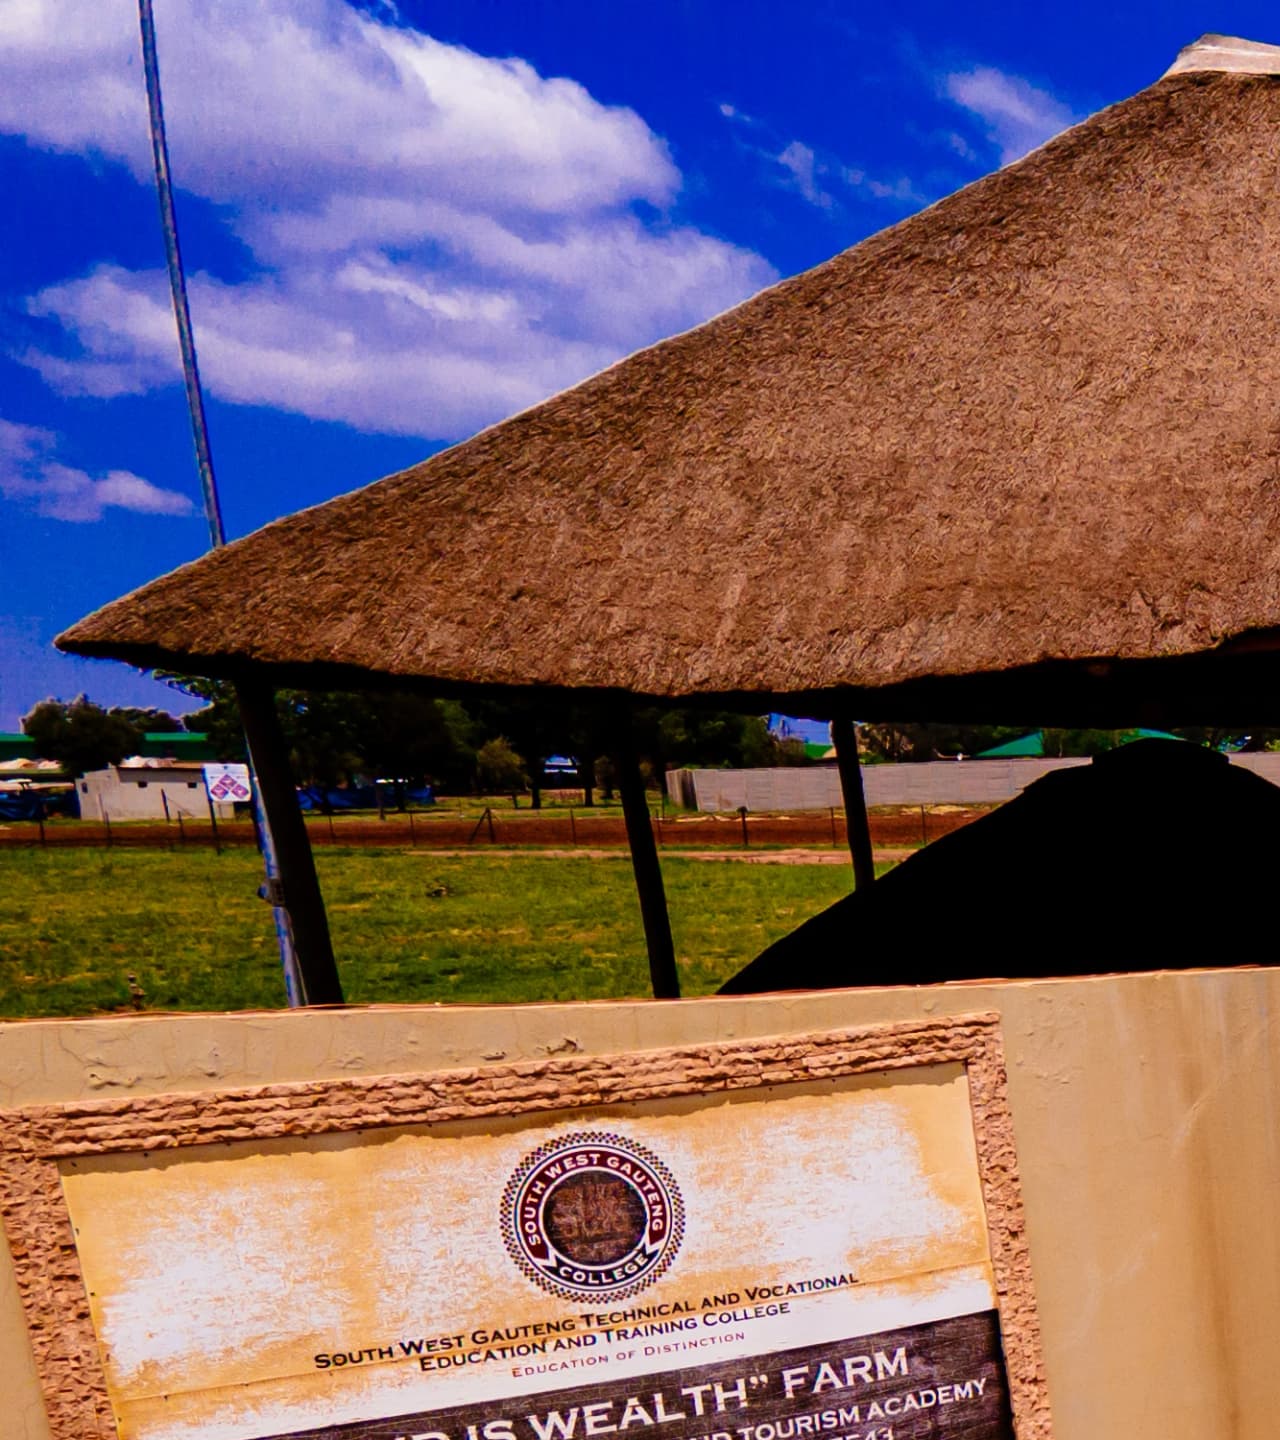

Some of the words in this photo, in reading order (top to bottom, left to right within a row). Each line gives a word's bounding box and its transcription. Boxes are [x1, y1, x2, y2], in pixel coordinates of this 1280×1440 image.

[524, 1179, 547, 1247] SOUTH
[544, 1152, 601, 1179] WEST
[606, 1155, 664, 1232] GAUTENG
[559, 1251, 650, 1285] COLLEGE
[314, 1345, 394, 1369] SOUTH
[400, 1334, 464, 1356] WEST
[471, 1318, 576, 1345] GAUTENG
[579, 1299, 696, 1330] TECHNICAL
[701, 1291, 740, 1309] AND
[744, 1273, 858, 1302] VOCATIONAL
[420, 1340, 547, 1372] EDUCATION
[553, 1334, 597, 1351] AND
[602, 1318, 698, 1344] TRAINING
[702, 1302, 791, 1327] COLLEGE
[512, 1354, 609, 1379] EDUCATION
[615, 1350, 636, 1361] OF
[643, 1331, 746, 1357] DISTINCTION
[781, 1346, 909, 1400] FARM
[866, 1377, 989, 1421] ACADEMY
